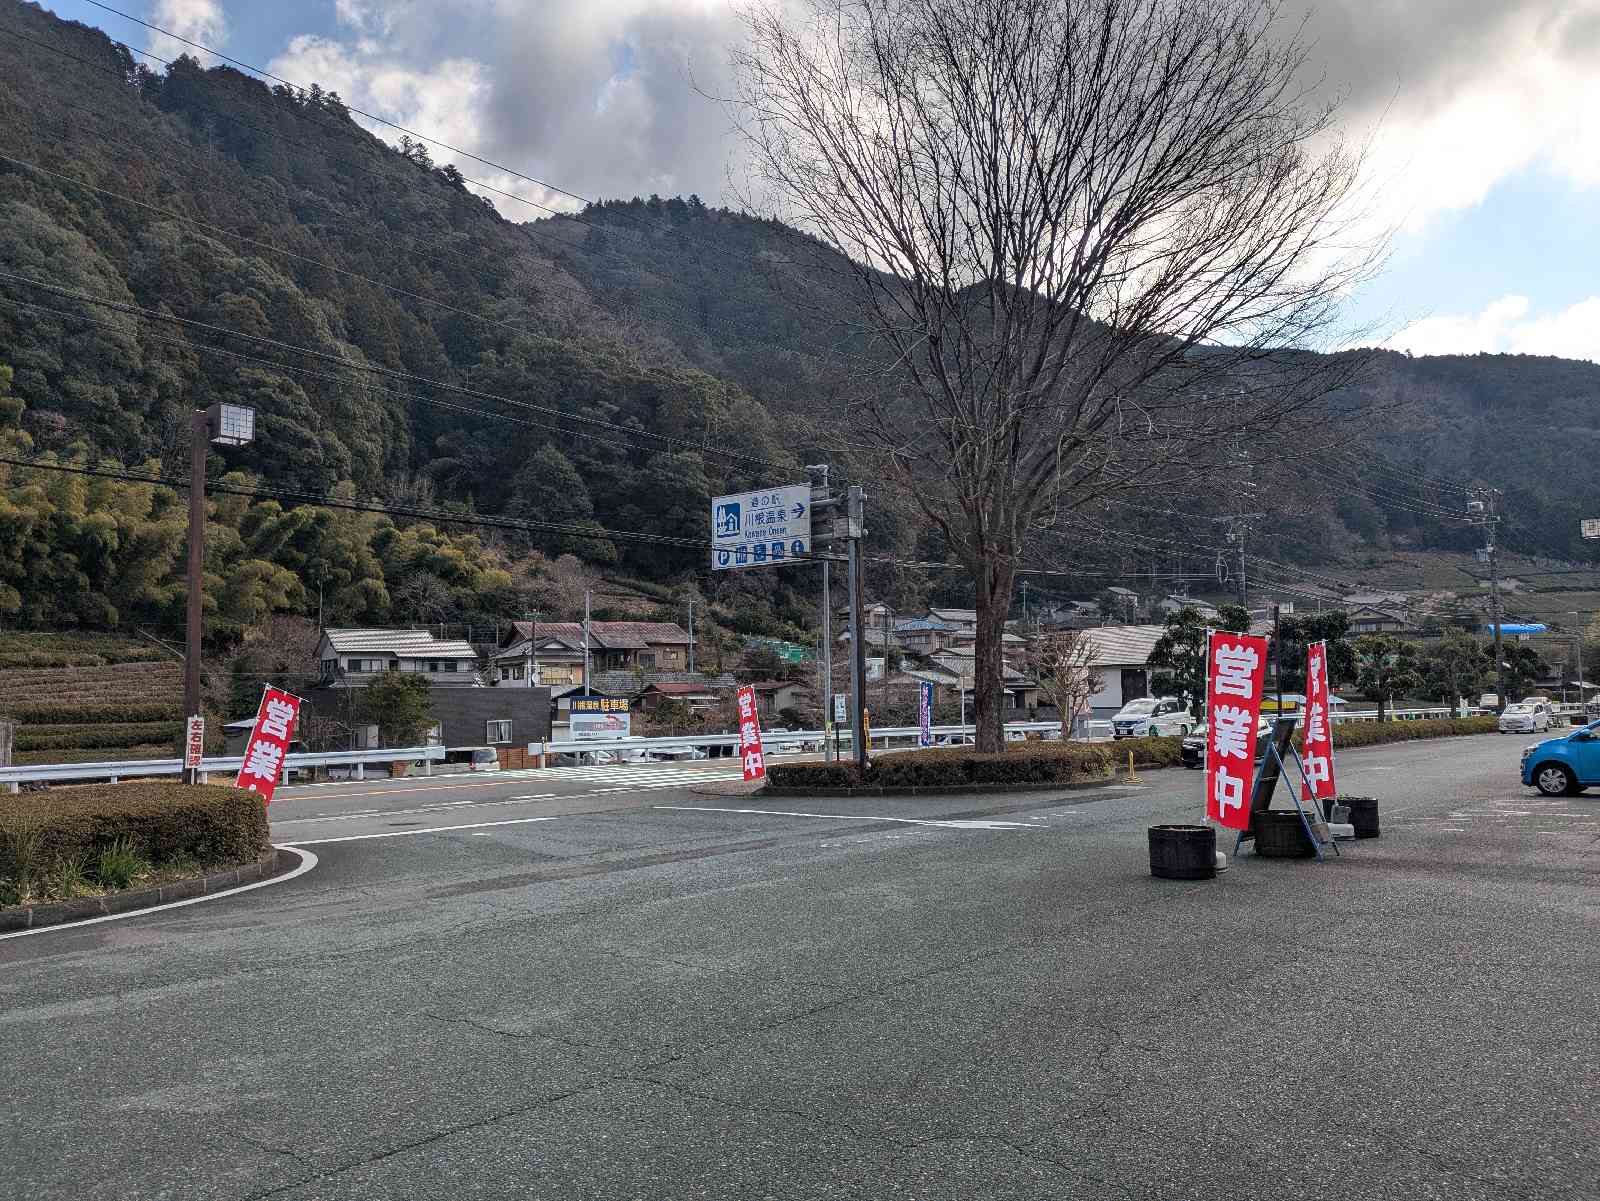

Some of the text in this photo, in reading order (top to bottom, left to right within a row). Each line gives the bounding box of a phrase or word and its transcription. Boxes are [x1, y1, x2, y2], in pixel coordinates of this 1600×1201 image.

[745, 510, 787, 526] 川根温泉
[768, 526, 787, 536] Onsen
[189, 719, 203, 768] 左右確認
[244, 697, 295, 801] 営業
[738, 692, 763, 777] 営業中
[1214, 643, 1259, 818] 営業中
